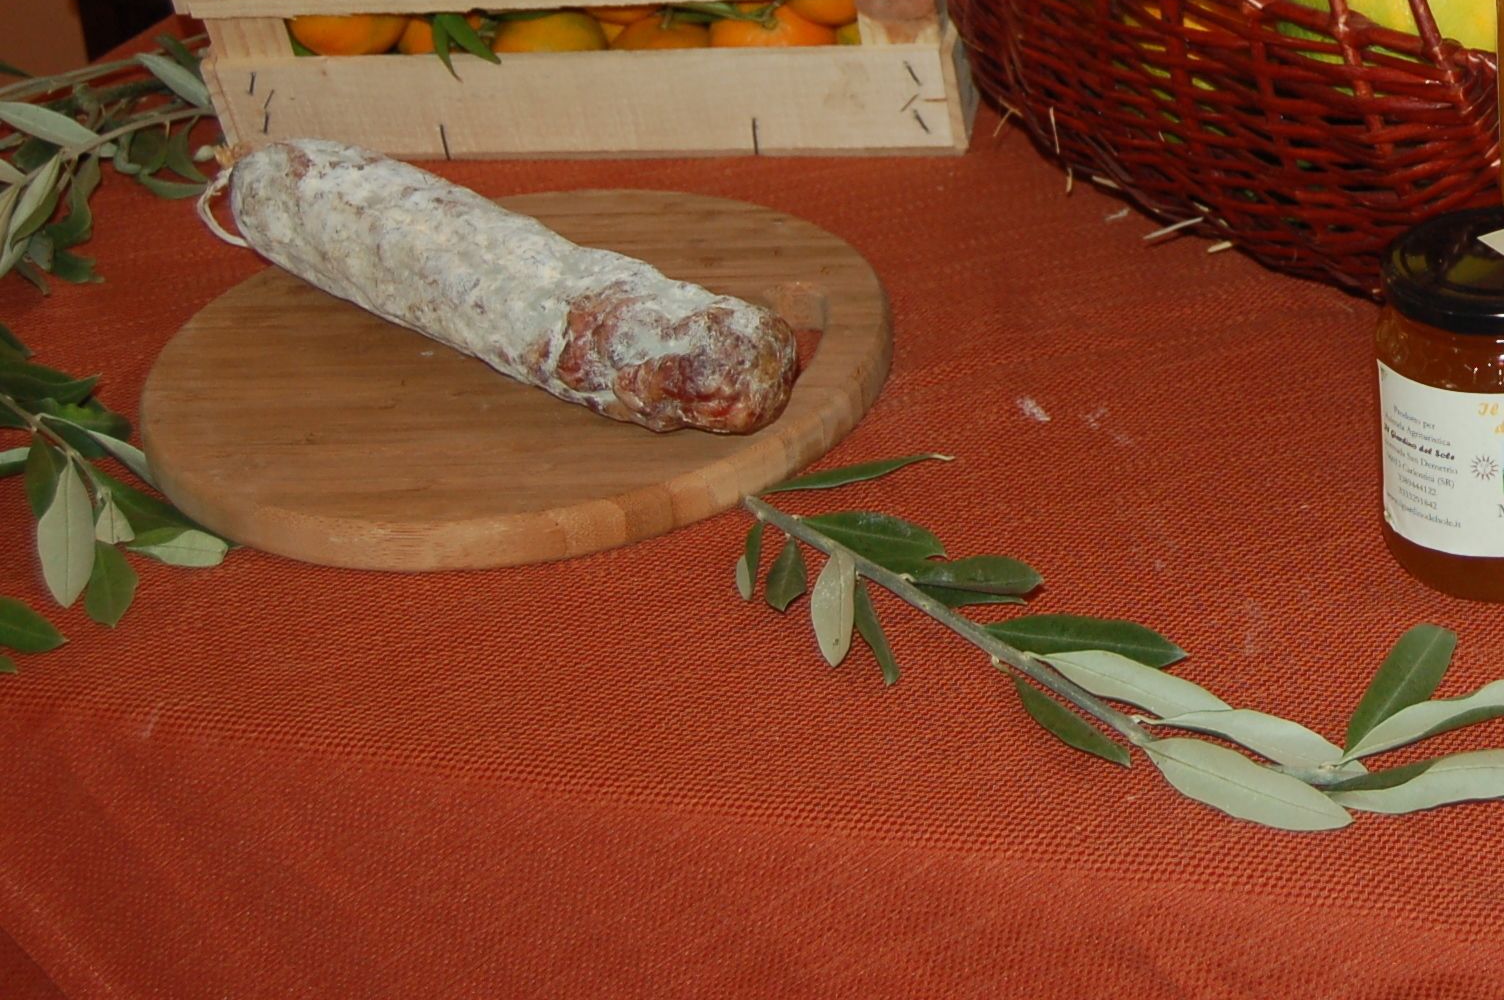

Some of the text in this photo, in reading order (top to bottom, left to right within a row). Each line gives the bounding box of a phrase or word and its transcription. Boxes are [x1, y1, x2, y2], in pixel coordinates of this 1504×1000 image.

[1477, 401, 1497, 416] Il
[1390, 430, 1417, 449] Giardino
[1435, 449, 1455, 460] Sole
[1438, 477, 1455, 488] (SR)
